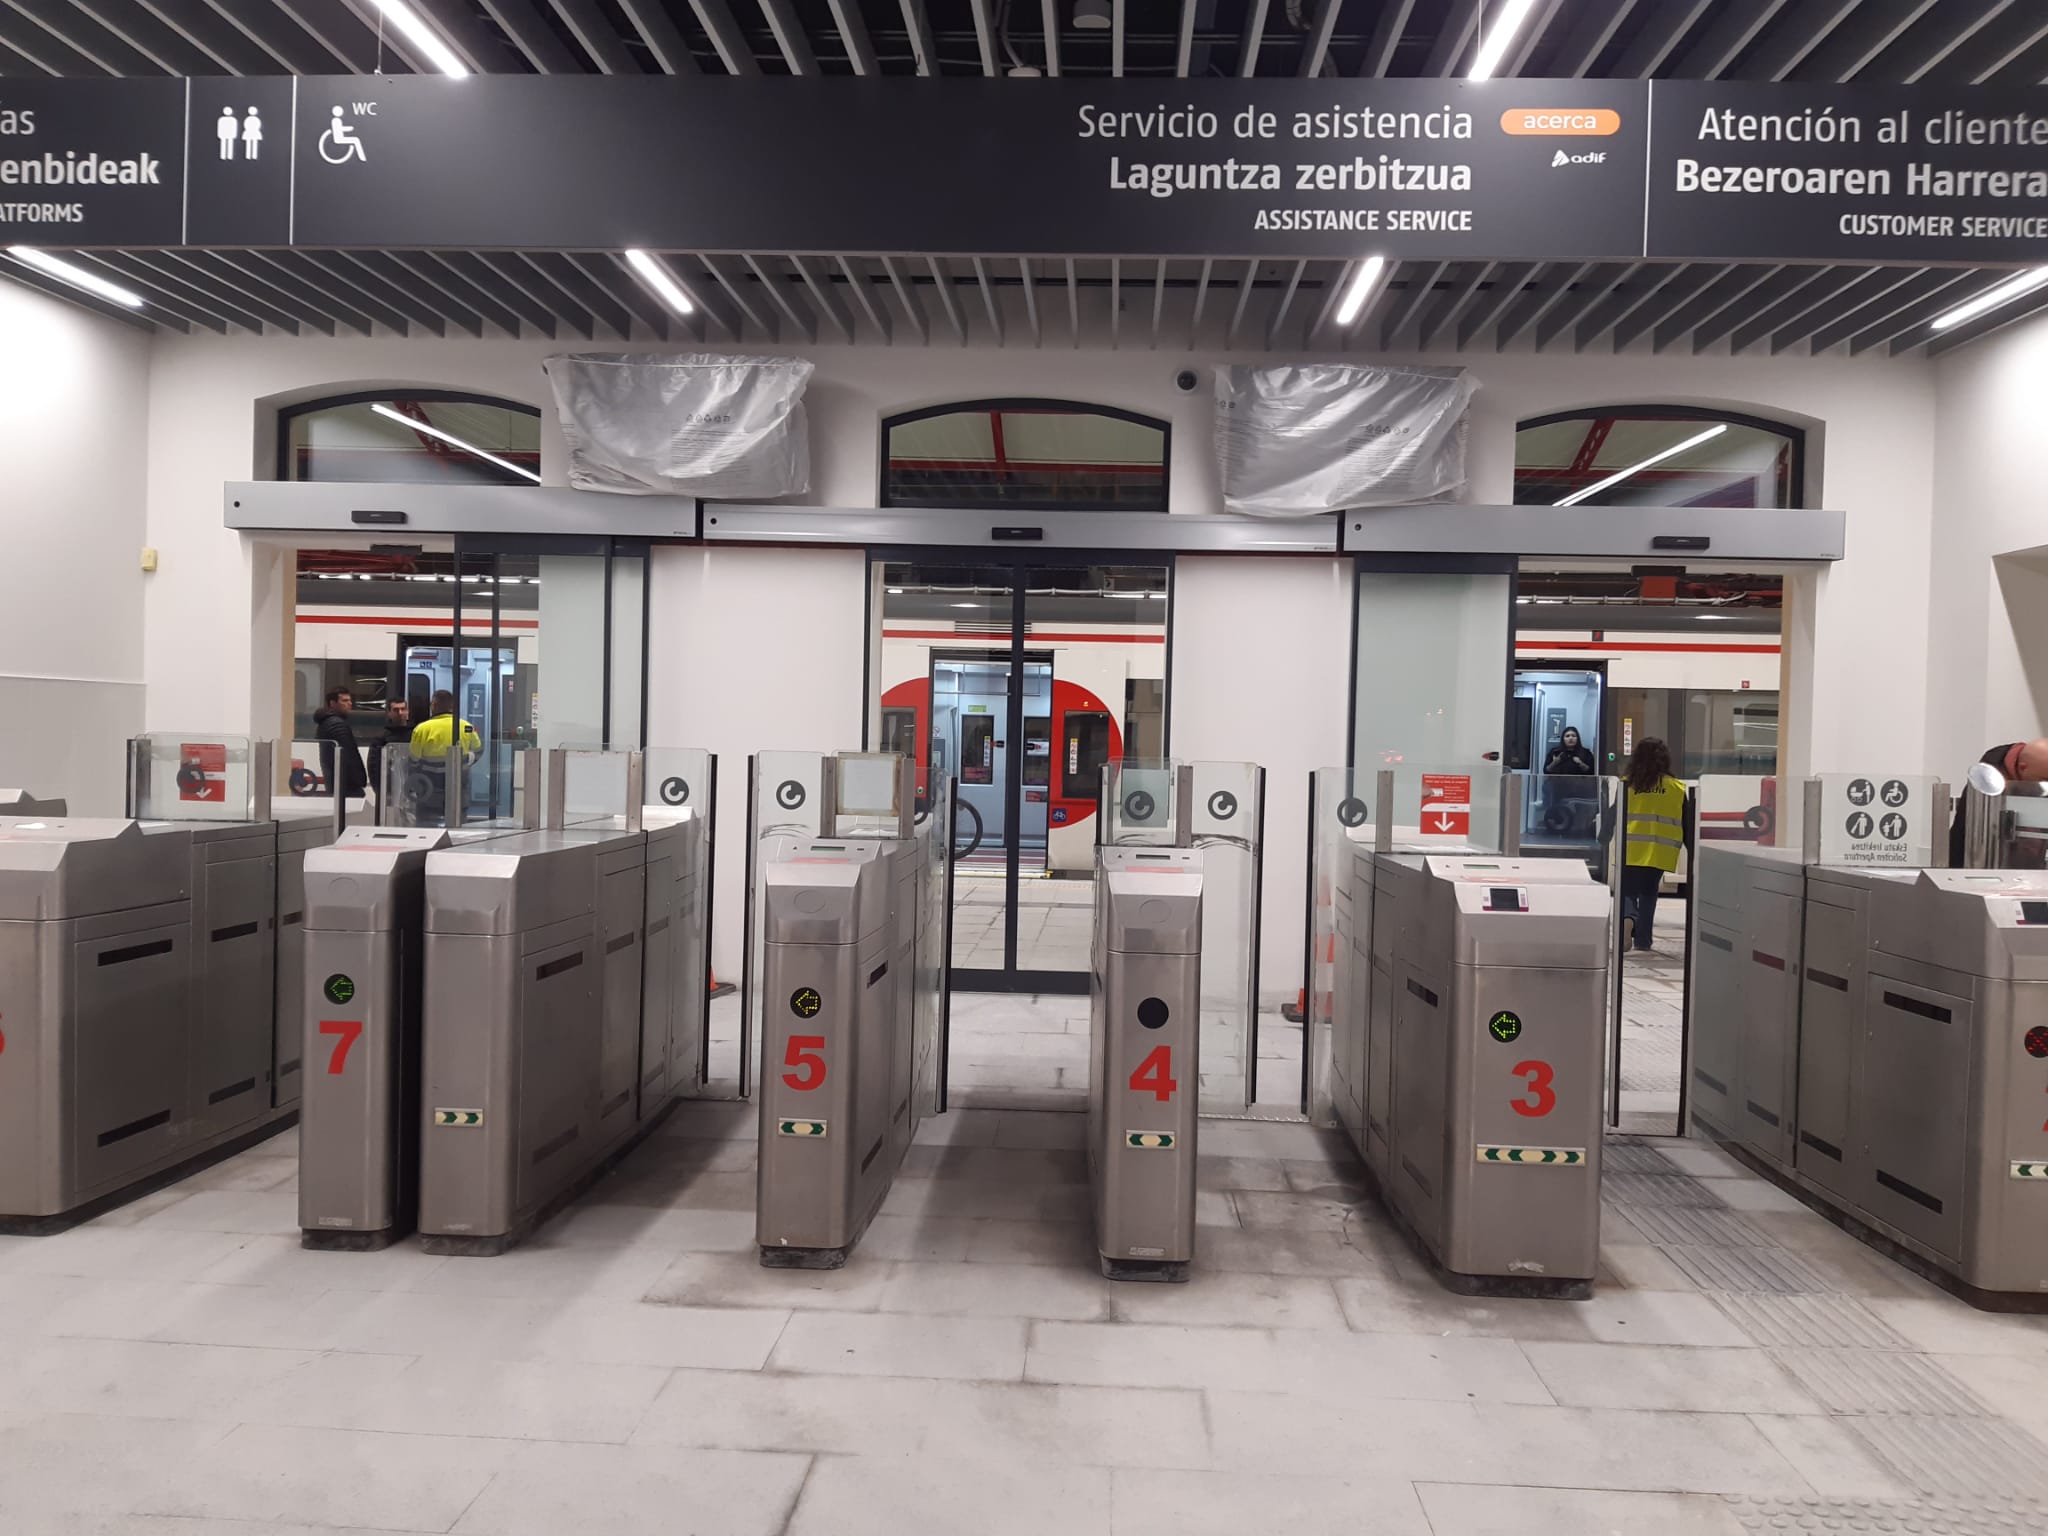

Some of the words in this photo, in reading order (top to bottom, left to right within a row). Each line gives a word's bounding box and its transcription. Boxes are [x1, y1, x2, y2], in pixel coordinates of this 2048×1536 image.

[0, 110, 35, 135] as
[351, 101, 377, 116] WC
[1078, 104, 1218, 138] Servicio
[1233, 104, 1277, 138] de
[1293, 105, 1472, 140] asistencia
[1523, 115, 1597, 129] acerca
[1698, 106, 1860, 142] Atención
[1877, 110, 1908, 144] al
[1925, 110, 2048, 145] cliente
[0, 150, 160, 185] enbideak
[1110, 156, 1281, 198] Laguntza
[1295, 156, 1472, 191] zerbitzua
[1676, 158, 1890, 195] Bezeroaren
[1906, 162, 2048, 197] Harrera
[1254, 209, 1380, 231] ASSISTANCE
[1386, 210, 1473, 231] SERVICE
[1839, 214, 1954, 237] CUSTOMER
[1961, 216, 2048, 238] SERVICE
[319, 1020, 363, 1076] 7
[782, 1035, 827, 1092] 5
[1129, 1045, 1178, 1103] 4
[1510, 1060, 1557, 1118] 3
